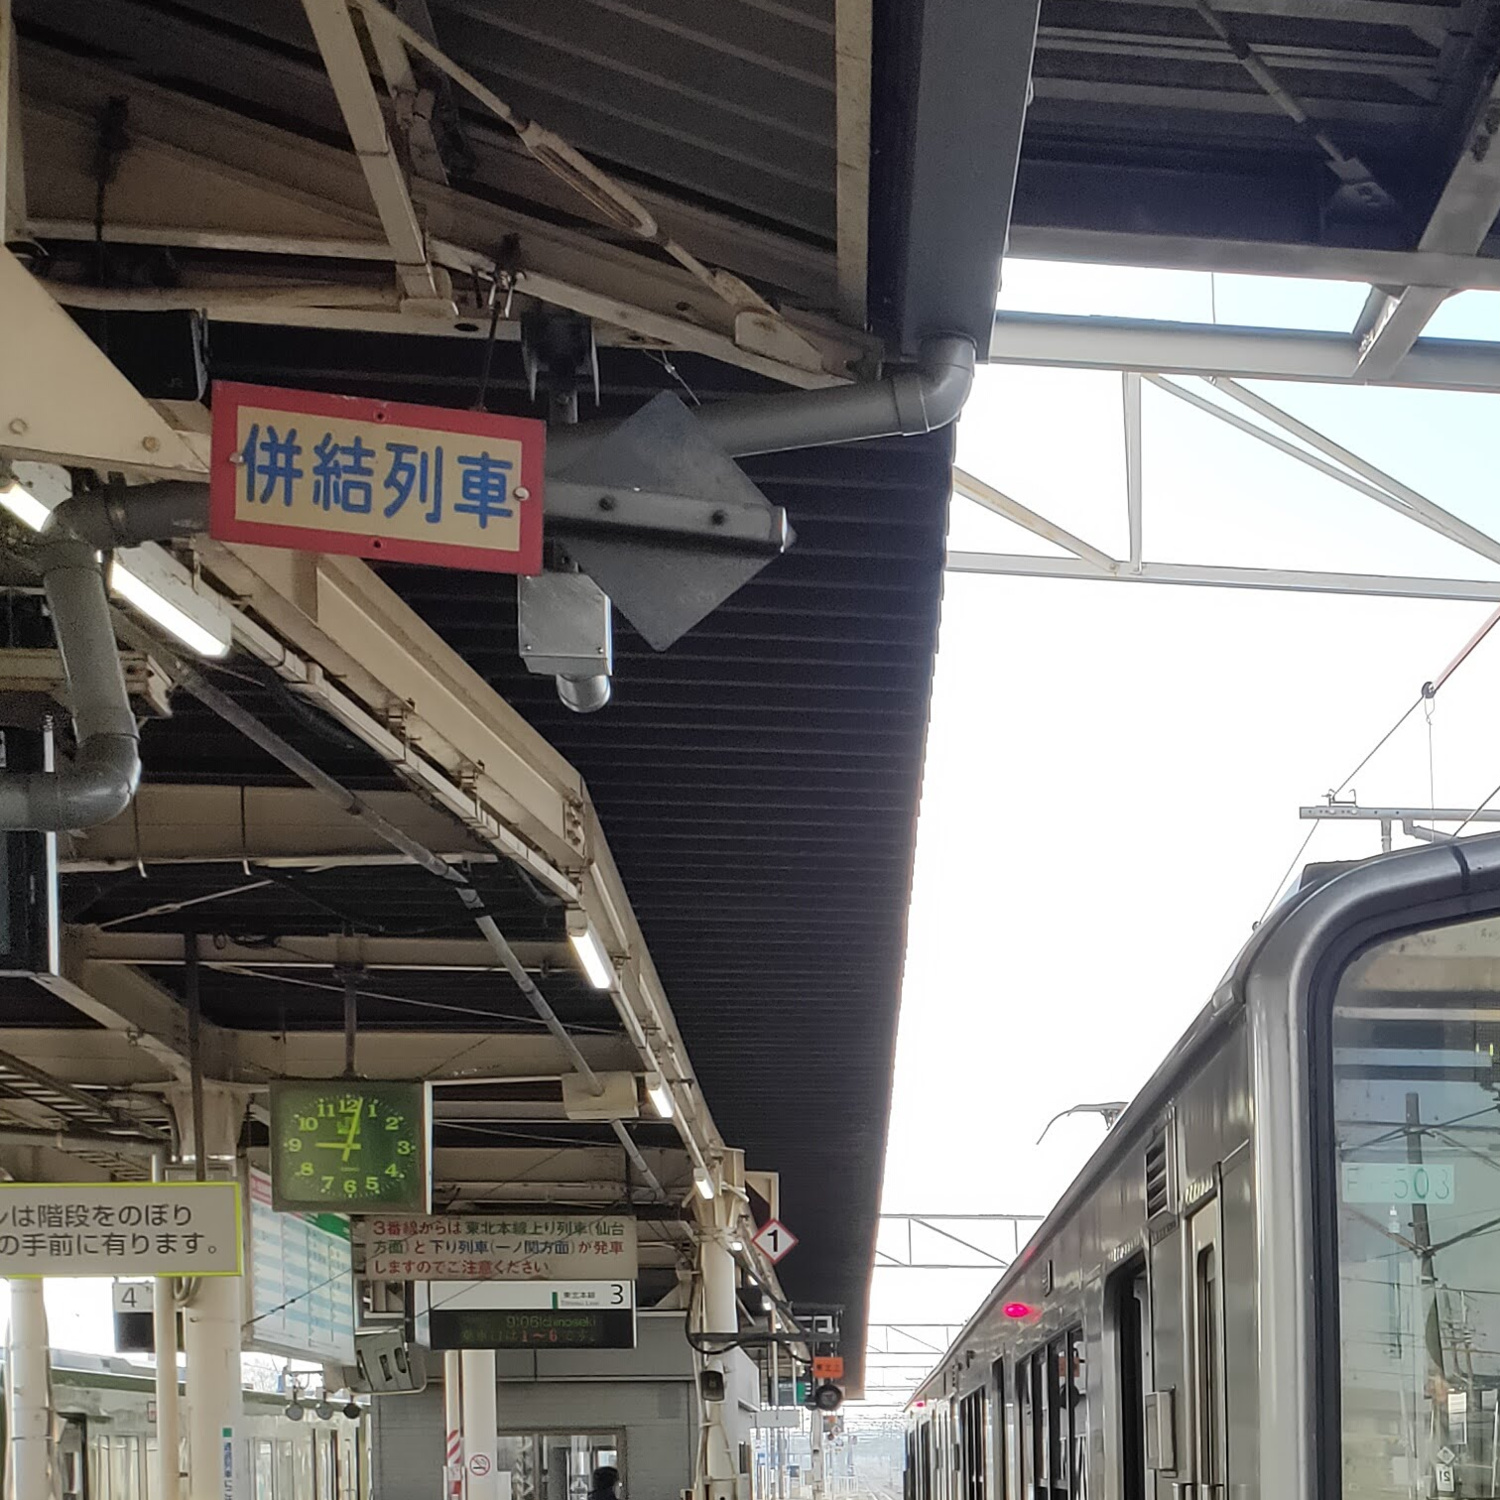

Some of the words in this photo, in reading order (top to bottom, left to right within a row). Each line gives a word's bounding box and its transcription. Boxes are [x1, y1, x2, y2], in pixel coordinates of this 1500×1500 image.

[243, 424, 514, 529] 併結列車
[318, 1104, 335, 1118] 11
[368, 1104, 377, 1118] 1
[299, 1117, 319, 1131] 10
[385, 1117, 399, 1130] 2
[288, 1138, 302, 1152] 9
[397, 1141, 410, 1155] 3
[301, 1162, 314, 1176] 8
[385, 1163, 398, 1177] 4
[321, 1176, 334, 1190] 7
[343, 1180, 357, 1194] 6
[366, 1176, 379, 1190] 5
[0, 1231, 217, 1256] の手前に有ります。
[767, 1228, 778, 1252] 1
[121, 1287, 138, 1308] 4
[611, 1284, 623, 1304] 3
